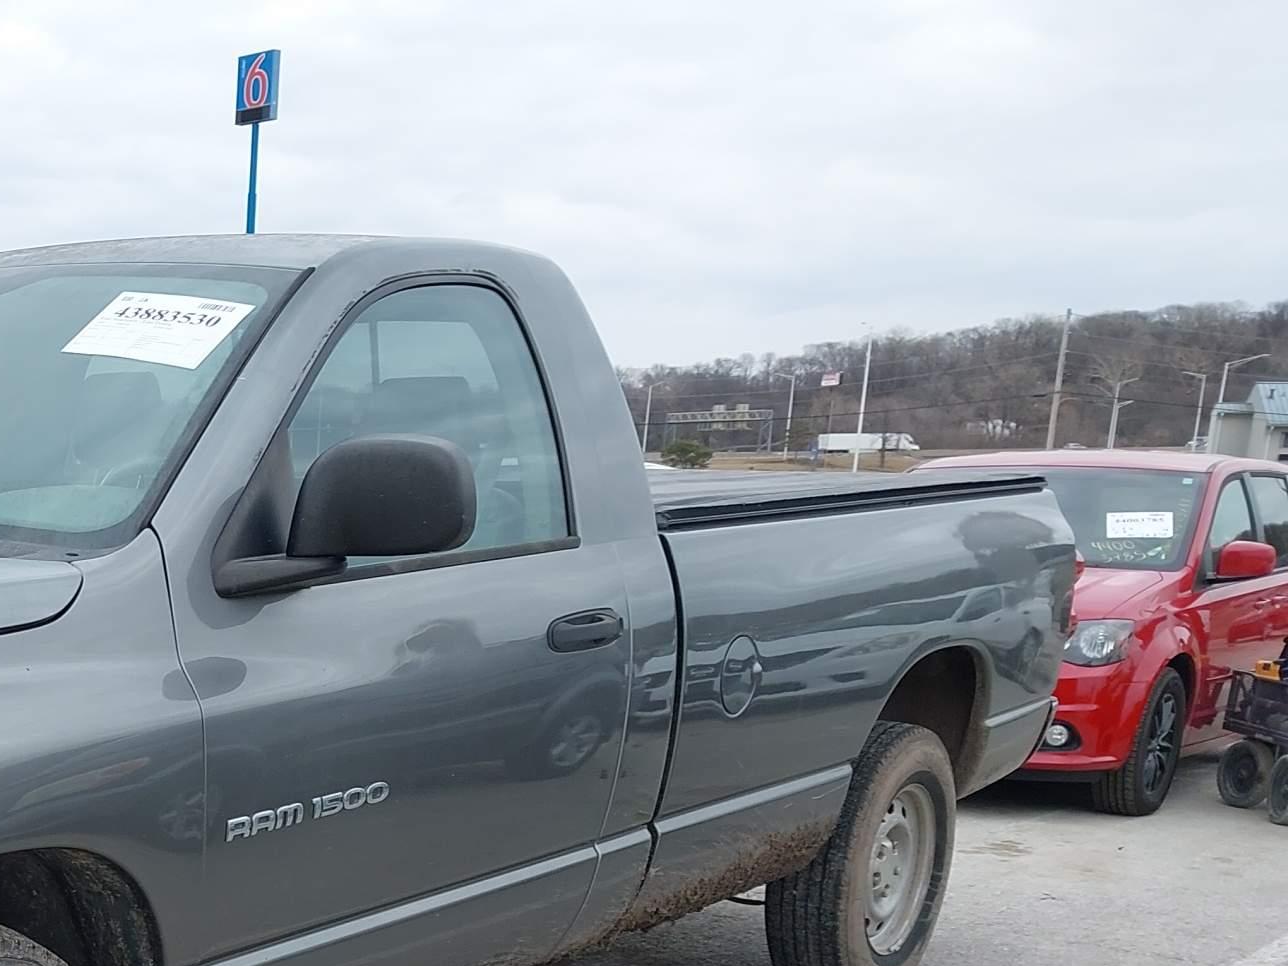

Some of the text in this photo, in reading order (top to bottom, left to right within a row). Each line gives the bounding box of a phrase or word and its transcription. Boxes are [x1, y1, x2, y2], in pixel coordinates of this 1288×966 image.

[243, 52, 269, 108] 6
[114, 306, 222, 327] 43883530
[225, 781, 390, 842] RAM 1500
